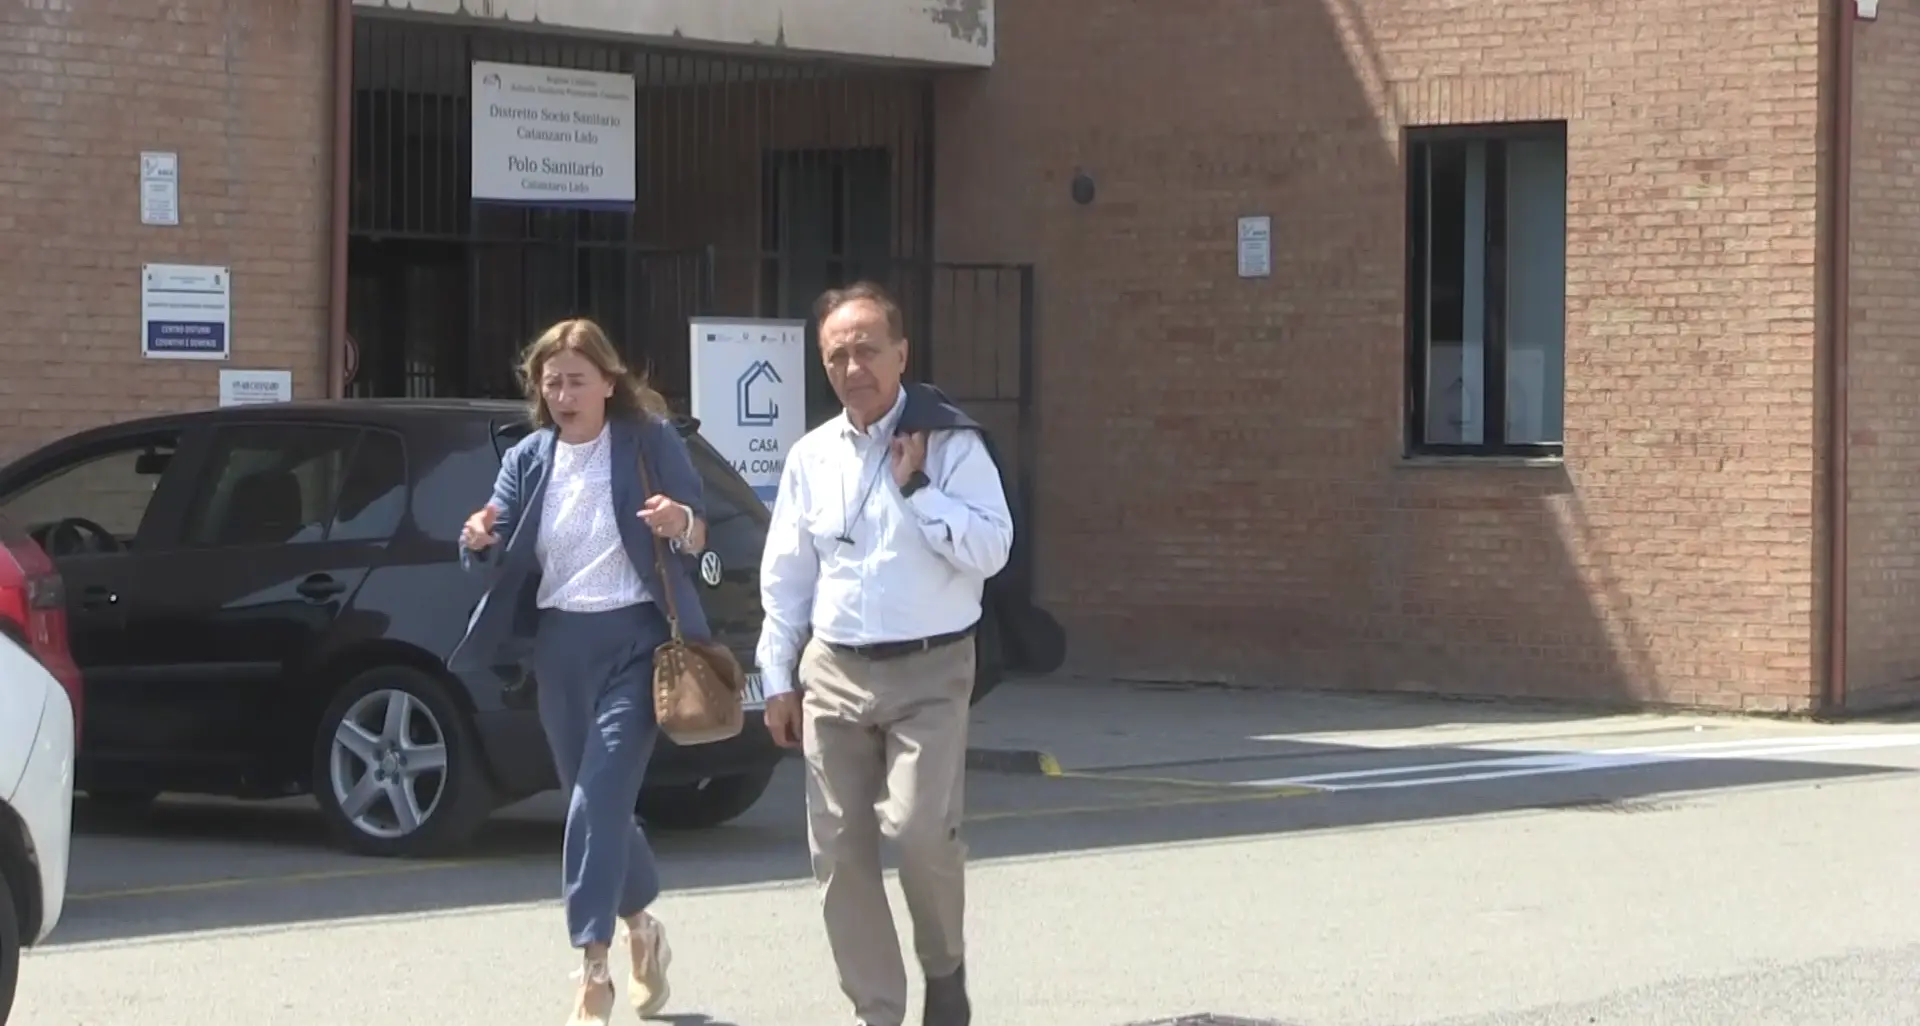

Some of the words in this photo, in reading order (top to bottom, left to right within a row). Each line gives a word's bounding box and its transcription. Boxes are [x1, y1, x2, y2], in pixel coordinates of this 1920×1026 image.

[489, 103, 538, 119] Distretto
[540, 107, 570, 122] Socio
[573, 111, 621, 128] Sanitario
[516, 125, 572, 142] Catanzaro
[574, 130, 599, 144] Lido
[508, 155, 538, 173] Polo
[541, 157, 604, 177] Sanitario
[520, 178, 567, 192] Catanzaro
[568, 182, 590, 193] Lido
[748, 438, 779, 452] CASA
